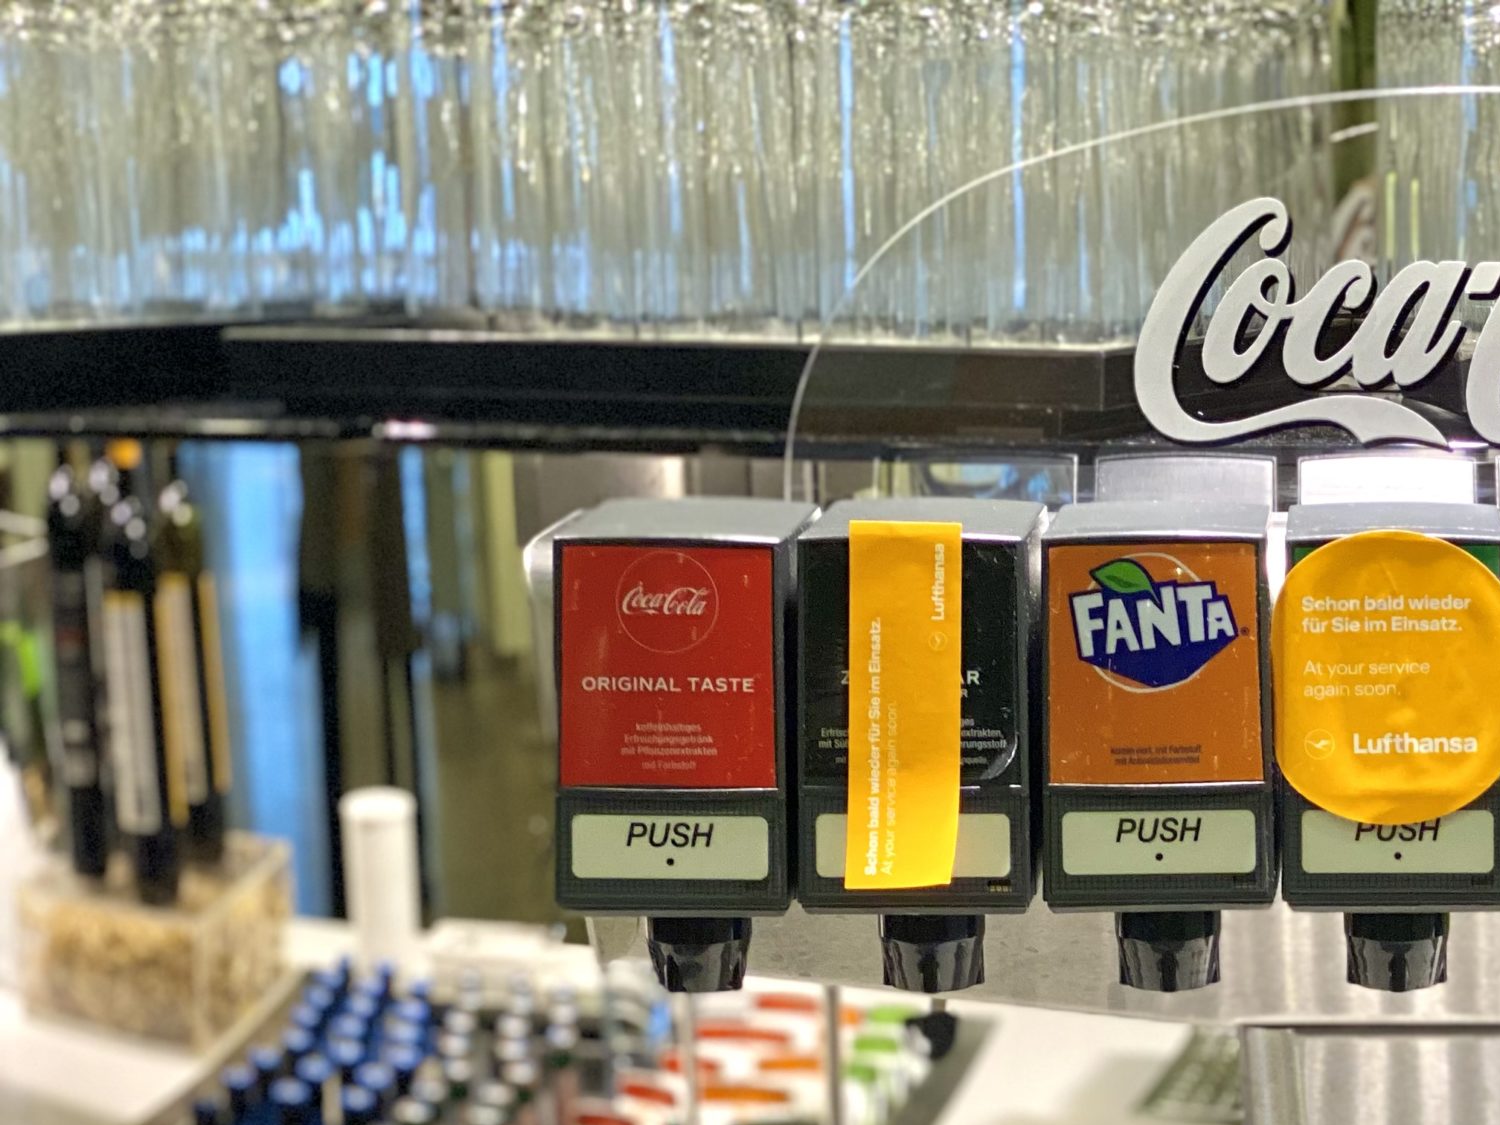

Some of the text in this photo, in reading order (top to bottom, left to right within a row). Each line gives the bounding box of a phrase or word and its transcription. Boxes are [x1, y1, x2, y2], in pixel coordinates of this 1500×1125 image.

[931, 543, 945, 621] Lufthansa
[621, 583, 709, 617] Coca-Cola
[1302, 594, 1471, 612] Schon bald wieder
[1070, 585, 1236, 658] FANTA
[1302, 616, 1462, 633] für Sie im Einsatz.
[1303, 660, 1431, 678] At your service
[581, 675, 755, 694] ORIGINAL TASTE
[1303, 684, 1401, 700] again soon.
[864, 617, 881, 877] Schon bald wieder für Sie im Einsatz.
[1353, 732, 1478, 754] Lufthansa
[880, 702, 899, 876] At your service again soon.
[626, 822, 714, 847] PUSH
[1115, 818, 1202, 842] PUSH
[1355, 822, 1440, 842] PUSH
